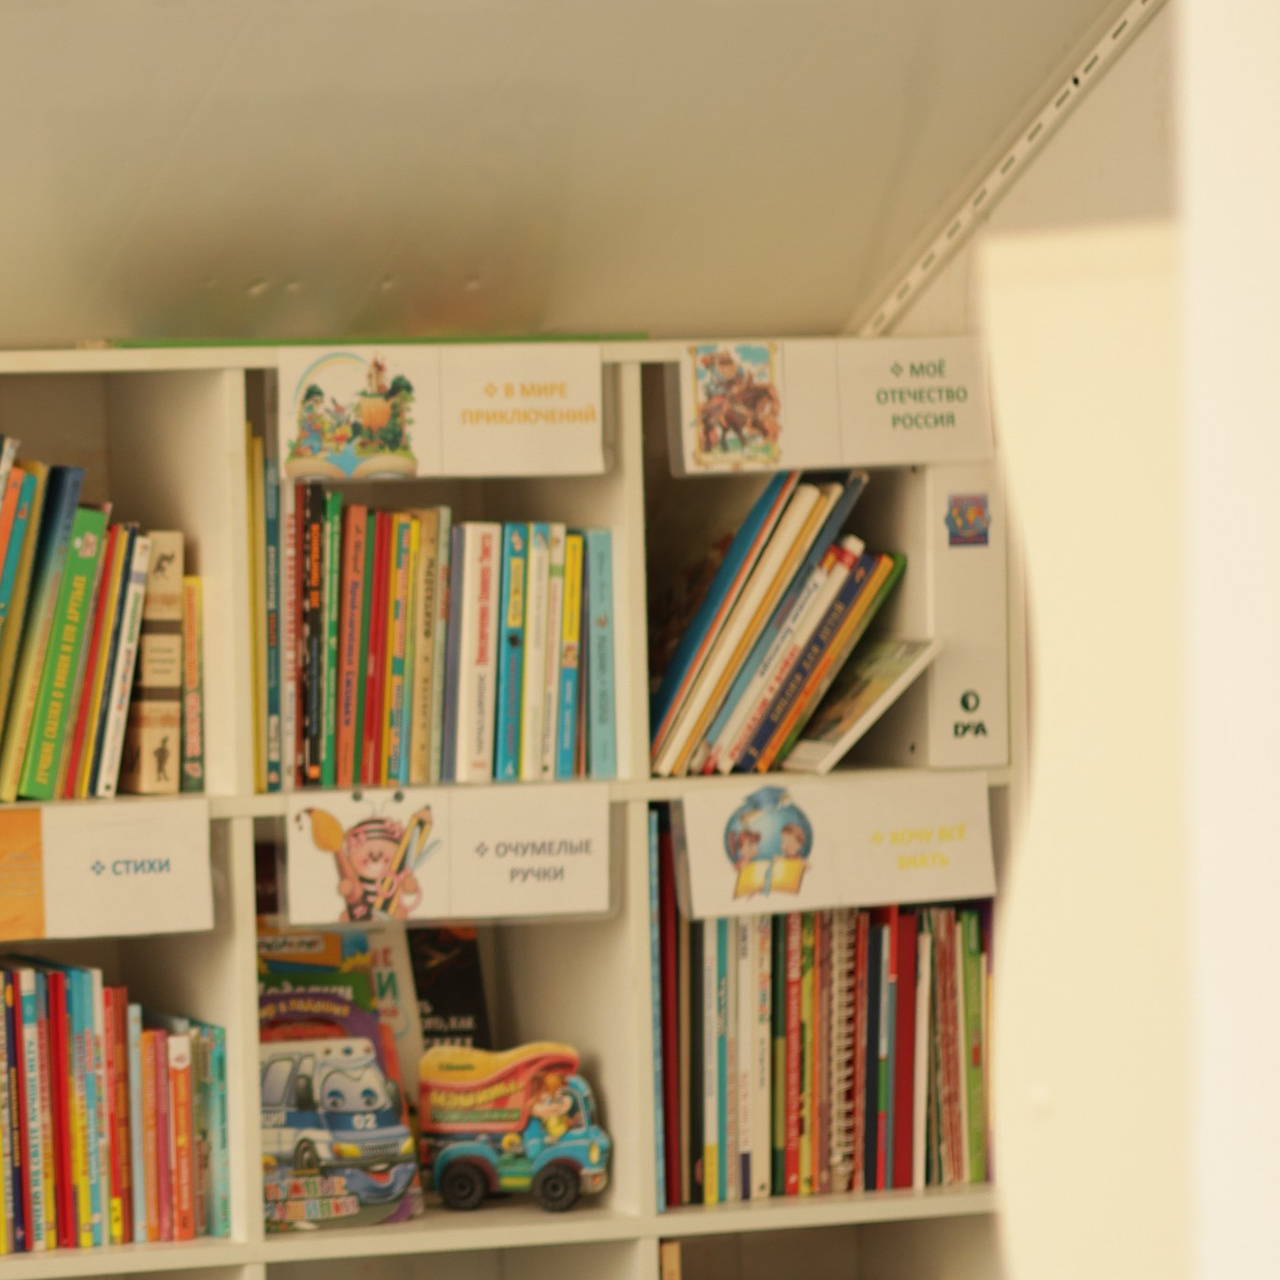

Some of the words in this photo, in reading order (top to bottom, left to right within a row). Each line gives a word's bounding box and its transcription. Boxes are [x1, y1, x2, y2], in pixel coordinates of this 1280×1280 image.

[909, 358, 946, 377] МОЁ
[503, 383, 515, 399] В
[519, 382, 568, 399] МИРЕ
[876, 387, 968, 406] ОТЕЧЕСТВО
[461, 406, 597, 426] ПРИКЛЮЧЕНИЙ
[891, 412, 956, 430] РОССИЯ
[311, 523, 320, 586] ПИНГВИНОВ
[66, 575, 87, 622] ДРУЗЬЯХ
[310, 590, 320, 608] 365
[423, 557, 435, 639] ФАНТАЗЁРЫ
[60, 623, 77, 641] ЕГО
[42, 700, 63, 739] СКАЗКИ
[34, 741, 55, 786] ЛУЧШИЕ
[890, 828, 933, 845] ХОЧУ
[495, 839, 593, 858] ОЧУМЕЛЫЕ
[111, 858, 172, 876] СТИХИ
[897, 852, 951, 871] ЗНАТЬ
[509, 865, 565, 883] РУЧКИ
[25, 1039, 36, 1073] НЕТУ
[27, 1077, 38, 1122] ЛУЧШЕ
[352, 1113, 377, 1130] 02
[29, 1128, 40, 1165] СВЕТЕ
[32, 1170, 41, 1186] НА
[32, 1190, 43, 1242] НИЧЕГО
